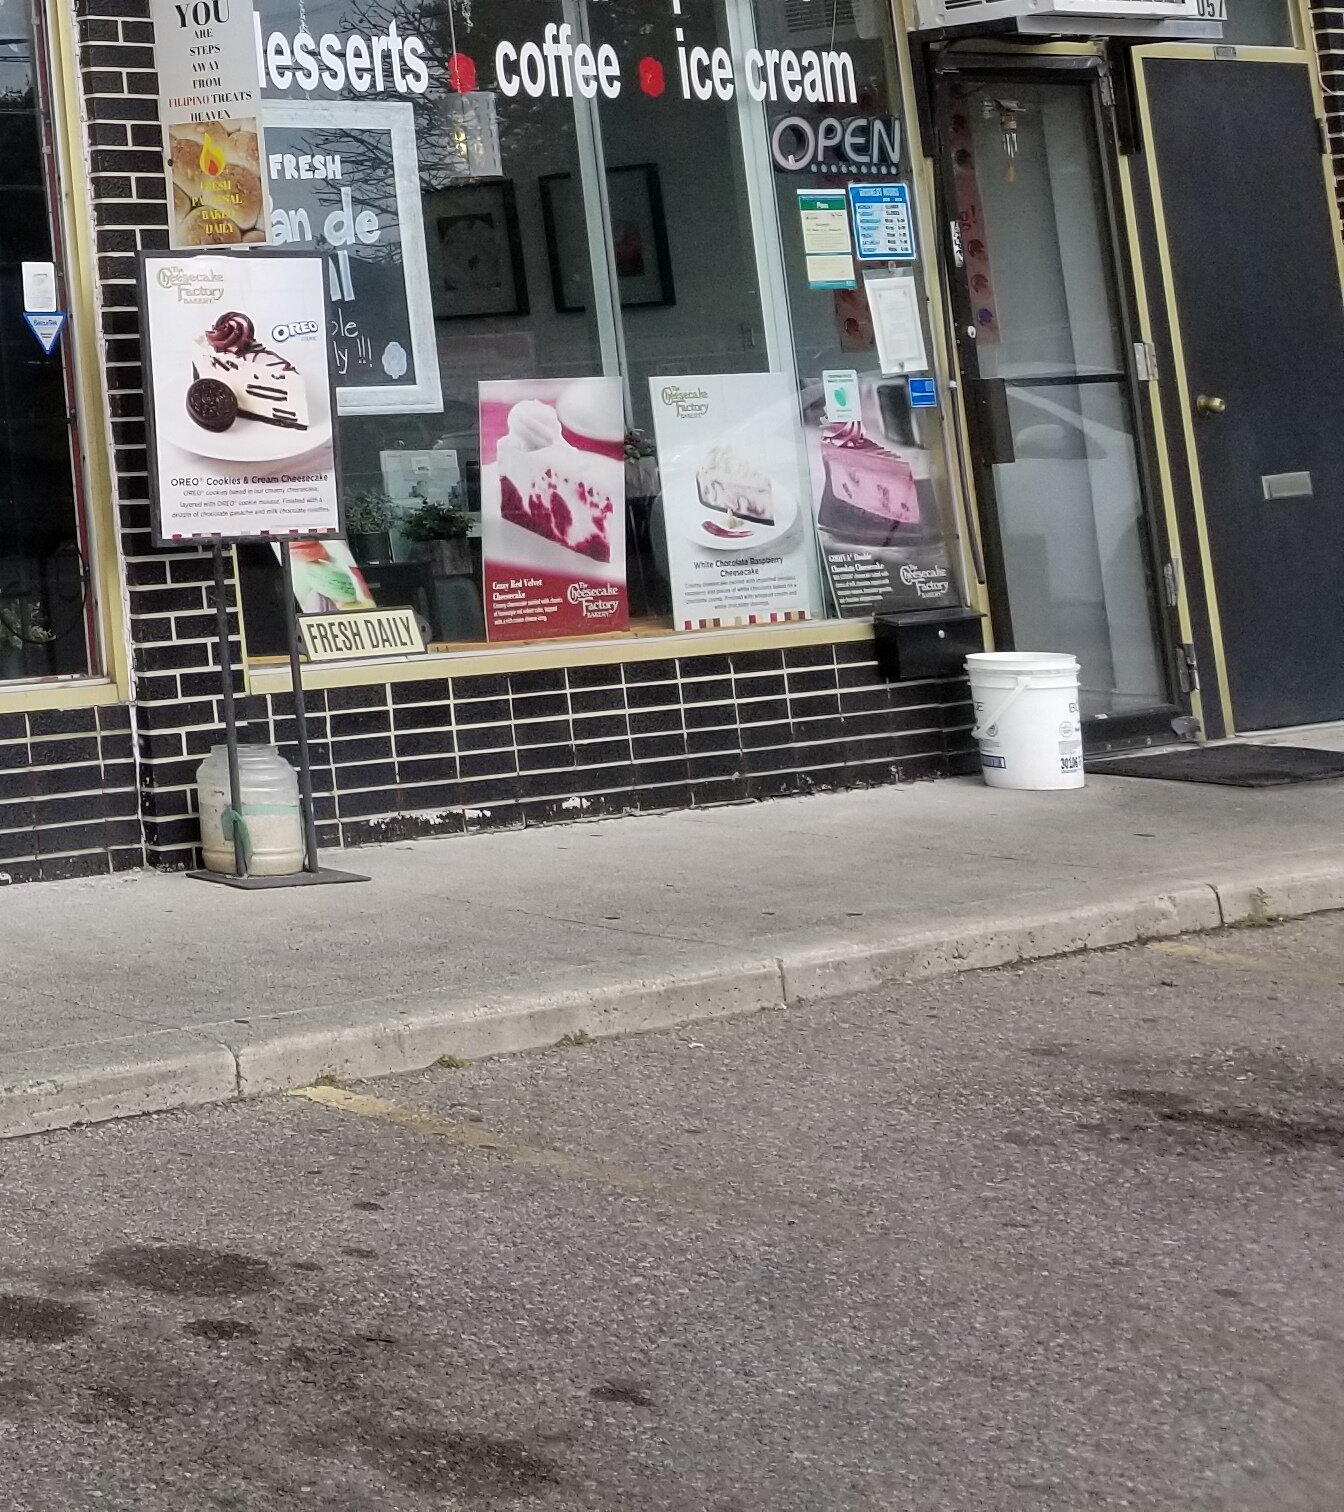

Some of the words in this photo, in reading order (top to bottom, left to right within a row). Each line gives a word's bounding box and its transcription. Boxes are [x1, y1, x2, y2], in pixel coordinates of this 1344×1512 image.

[189, 43, 221, 57] STEPS
[494, 22, 622, 100] coffee
[675, 27, 734, 101] ice
[745, 41, 859, 104] cream
[192, 77, 222, 89] FROM
[211, 91, 253, 104] TREATS
[772, 116, 901, 171] OPEN
[269, 154, 343, 180] FRESH
[268, 206, 312, 246] an
[323, 187, 382, 246] de
[272, 320, 319, 343] OREO
[580, 599, 619, 616] Factory
[306, 620, 364, 654] FRESH
[364, 616, 415, 649] DAILY
